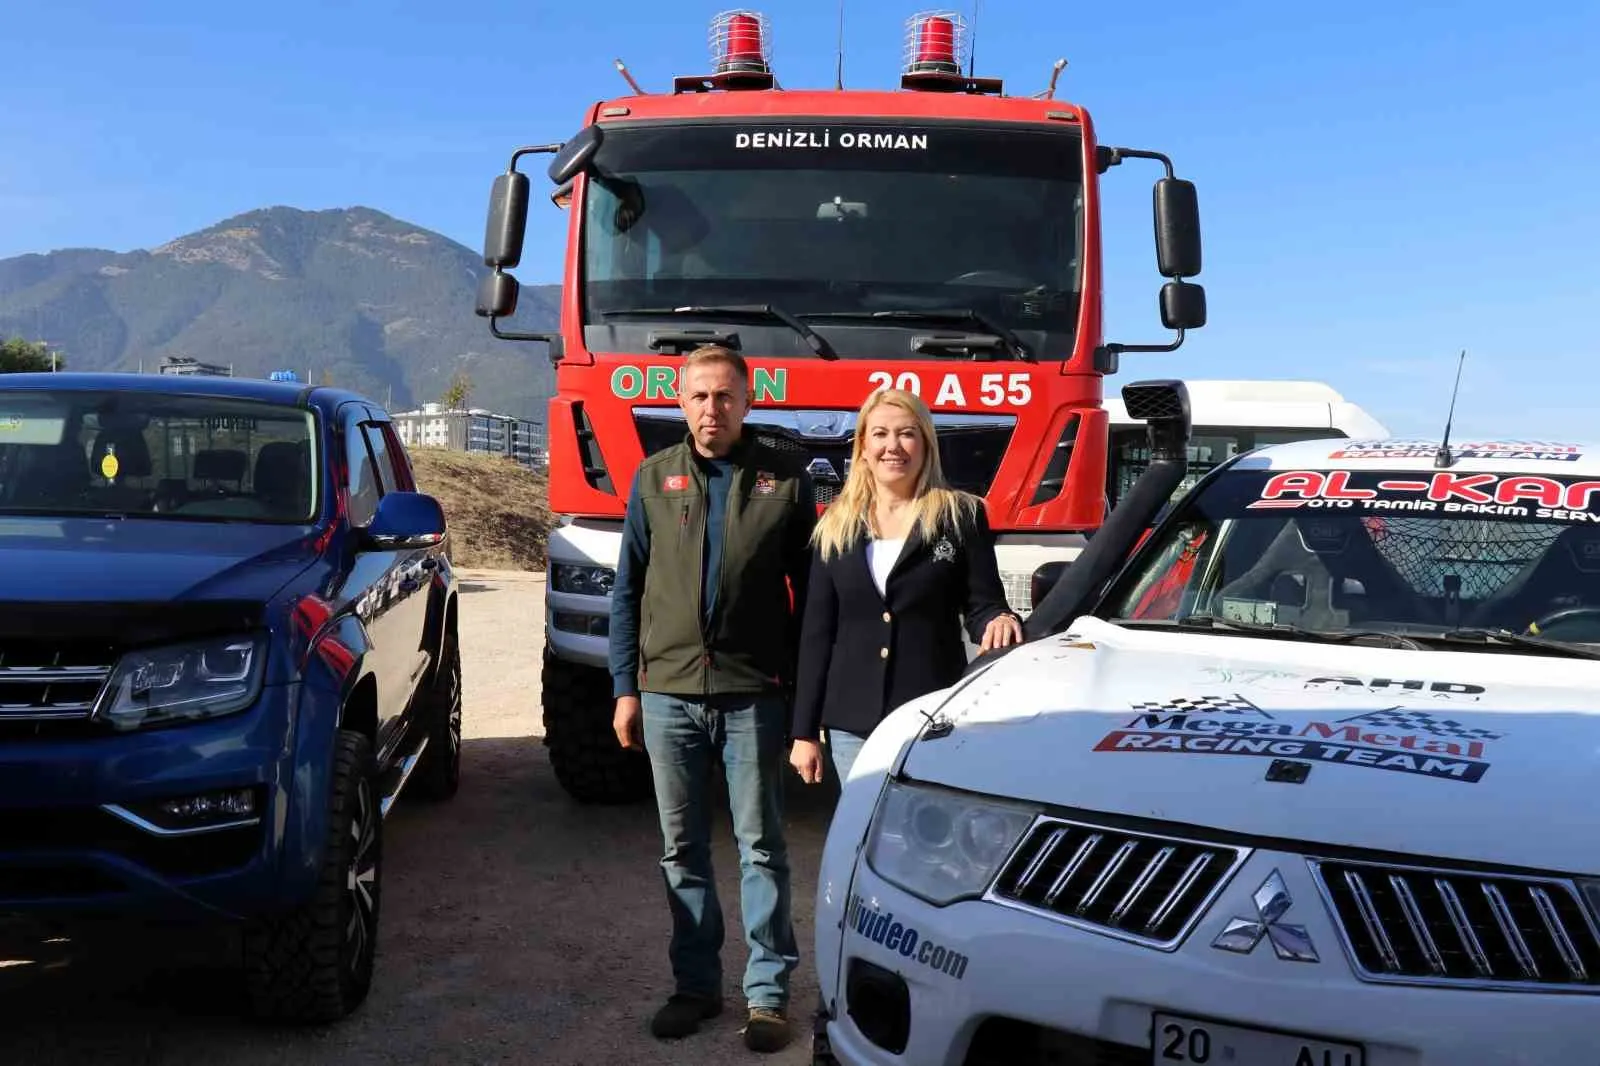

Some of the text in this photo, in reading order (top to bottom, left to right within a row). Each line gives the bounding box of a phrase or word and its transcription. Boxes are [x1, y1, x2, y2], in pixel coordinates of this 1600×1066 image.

[735, 128, 928, 149] DENİZLİ ORMAN
[611, 365, 787, 402] ORN
[934, 373, 967, 406] A
[979, 373, 1032, 406] 55
[1307, 499, 1353, 508] OTO
[1444, 502, 1528, 516] BAKIM
[1115, 734, 1469, 777] RACING TEAM
[1162, 1023, 1211, 1064] 20
